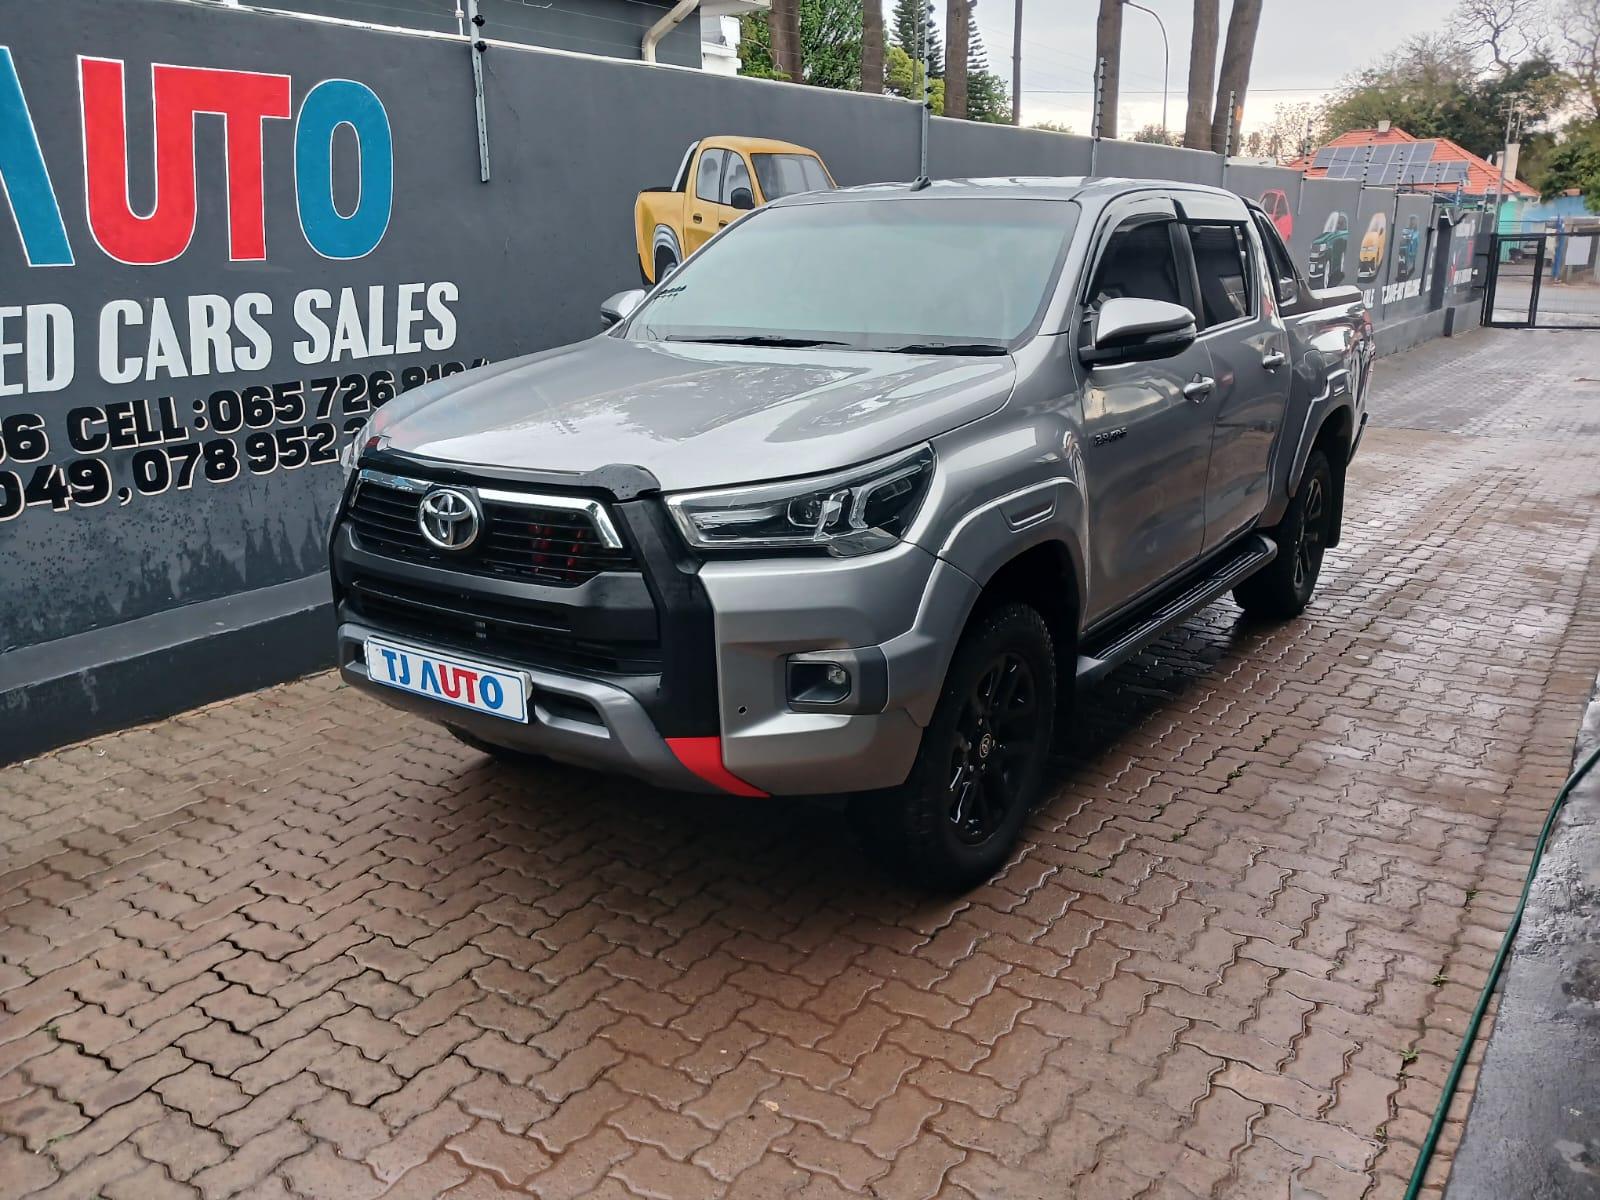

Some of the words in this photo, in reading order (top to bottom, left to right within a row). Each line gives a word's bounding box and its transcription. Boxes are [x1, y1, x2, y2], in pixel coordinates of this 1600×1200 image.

[98, 292, 272, 384] CARS
[293, 281, 459, 364] SALES
[0, 413, 49, 463] 6
[381, 649, 410, 685] TJ
[421, 660, 504, 710] AUTO
